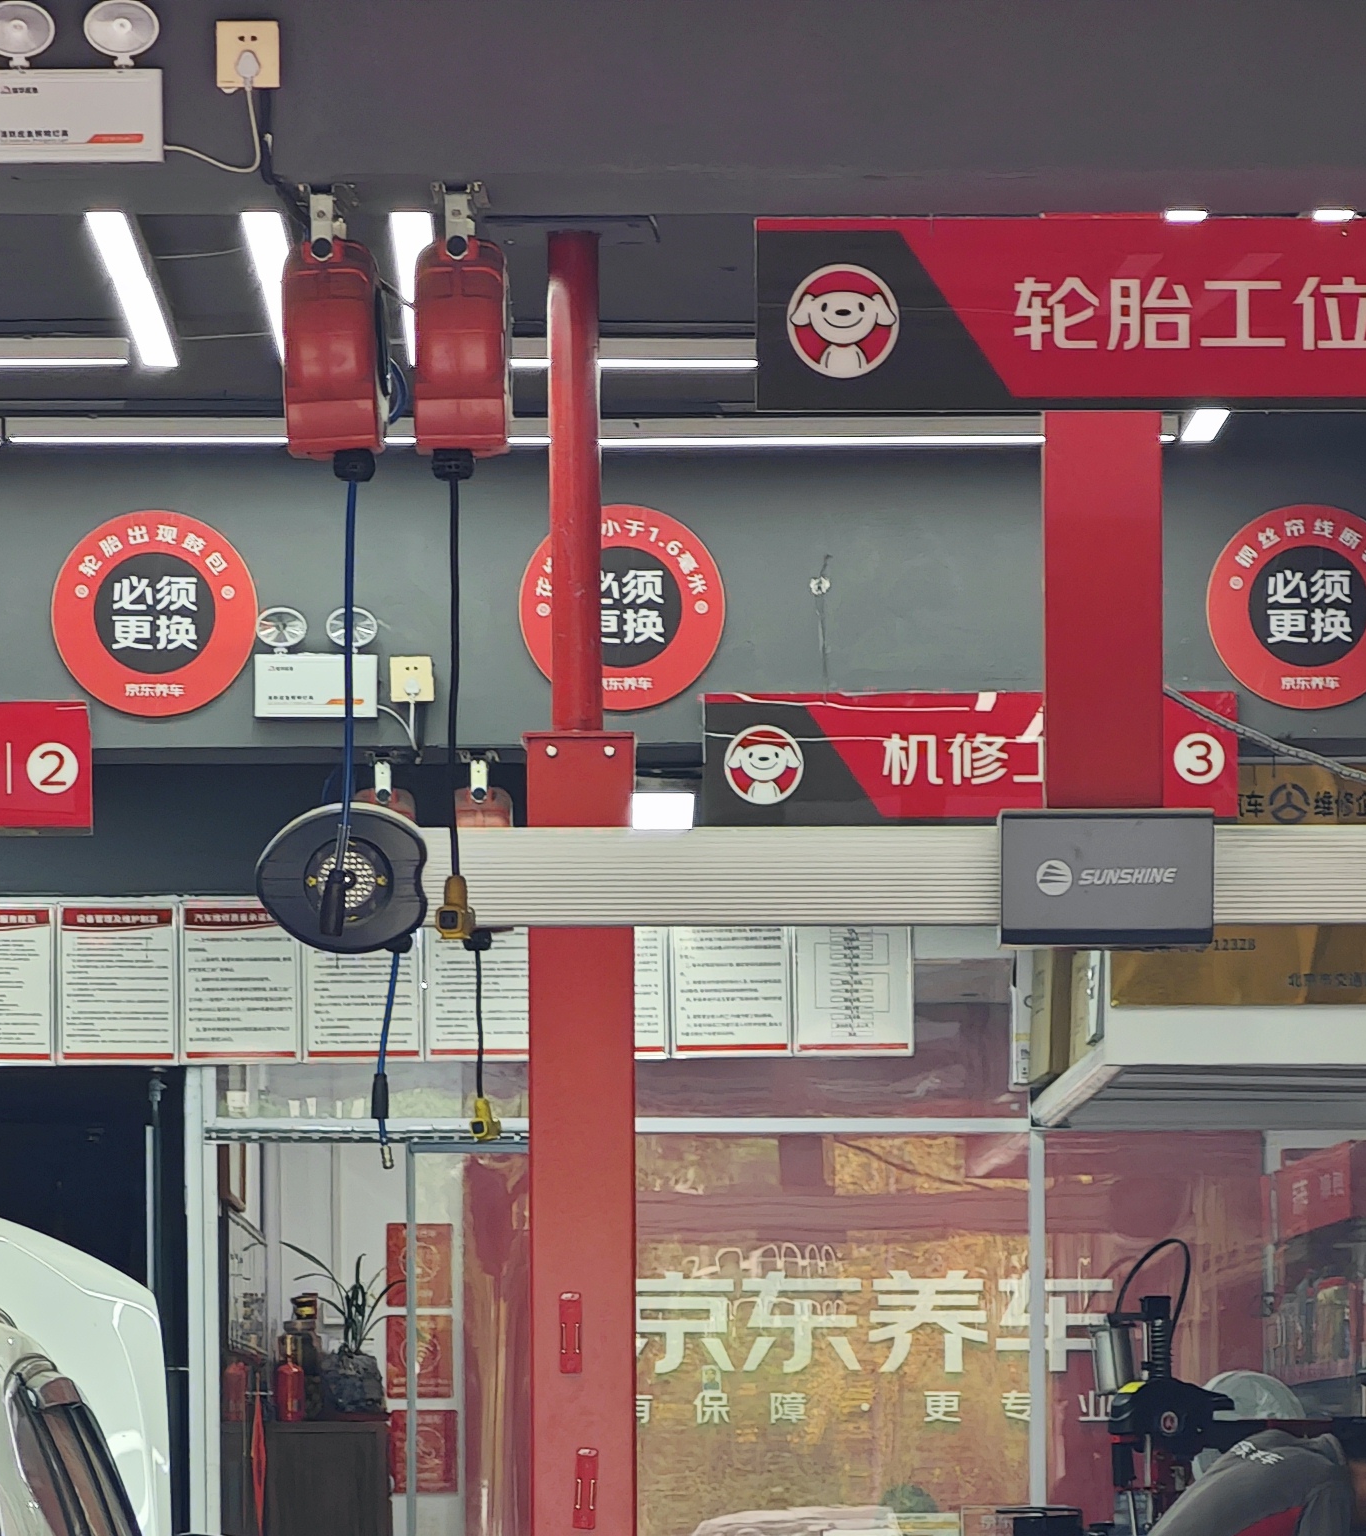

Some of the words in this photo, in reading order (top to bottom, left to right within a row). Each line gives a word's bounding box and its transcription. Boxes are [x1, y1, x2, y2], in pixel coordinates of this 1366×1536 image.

[78, 524, 230, 578] 轮胎出现鼓包
[112, 575, 198, 612] 必须
[1267, 569, 1353, 604] 必须
[111, 614, 198, 651] 更换
[1266, 608, 1353, 644] 更换
[124, 683, 185, 697] 京东养车
[1281, 676, 1341, 690] 京东养车
[882, 732, 1045, 786] 机修工
[1077, 866, 1178, 887] SUNSHINE
[636, 1269, 1114, 1374] 京东养车
